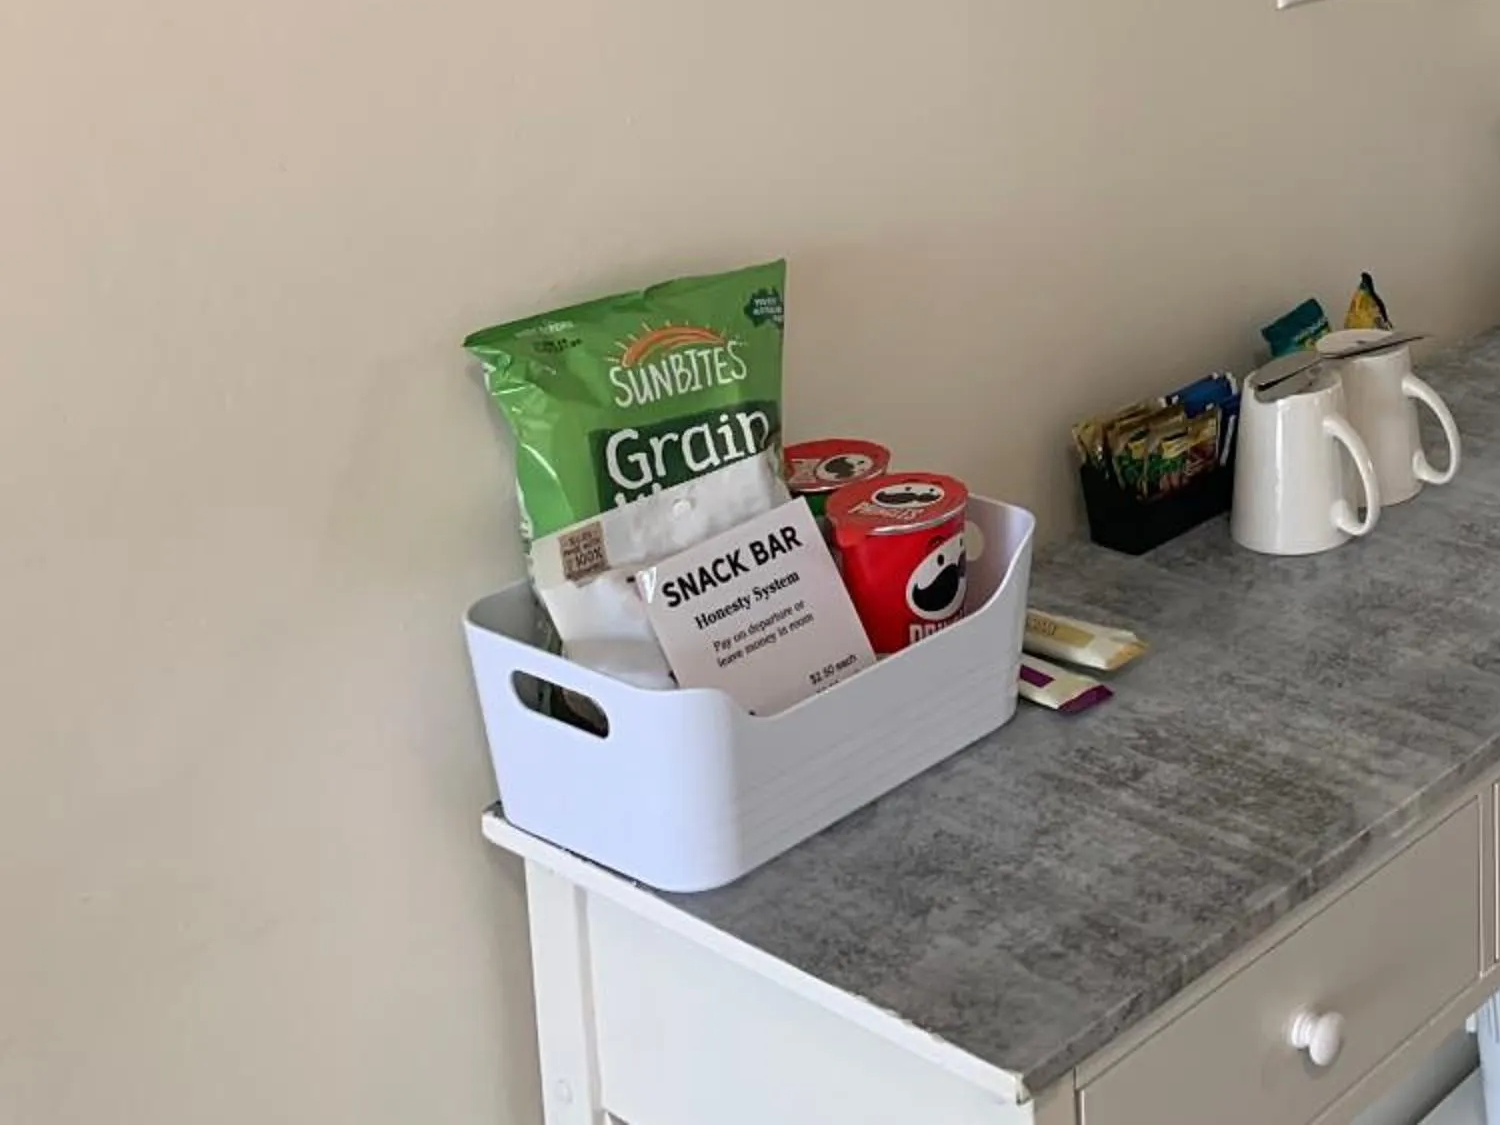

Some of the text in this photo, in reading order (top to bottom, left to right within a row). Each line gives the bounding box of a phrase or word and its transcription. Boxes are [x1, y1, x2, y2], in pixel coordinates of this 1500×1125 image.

[609, 341, 748, 408] SUNBITES
[606, 410, 769, 490] Grain
[662, 525, 803, 608] SNACK BAR
[694, 571, 801, 630] Honesty System
[712, 638, 732, 653] Pay
[733, 631, 747, 643] on
[747, 607, 793, 636] departure
[716, 649, 744, 668] leave
[744, 632, 778, 655] money
[789, 613, 814, 632] room
